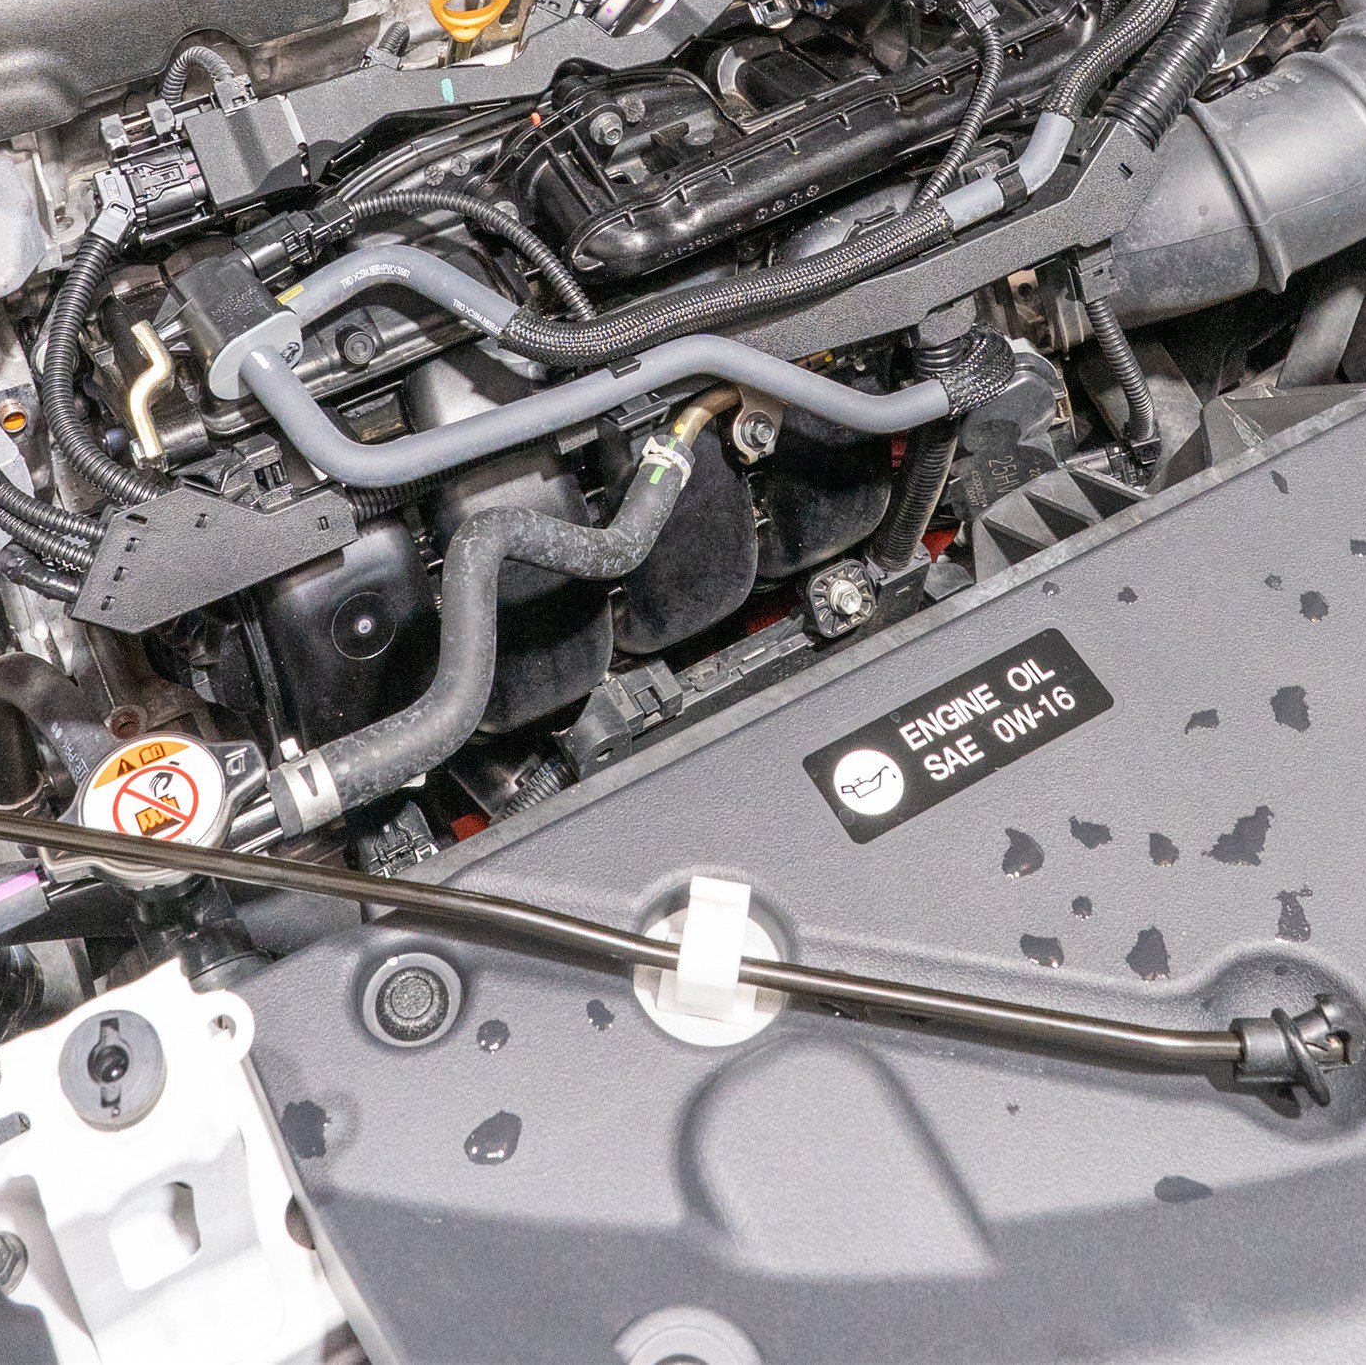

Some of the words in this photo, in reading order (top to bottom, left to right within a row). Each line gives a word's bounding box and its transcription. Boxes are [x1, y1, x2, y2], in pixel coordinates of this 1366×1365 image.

[898, 683, 1001, 751] ENGINE
[1007, 658, 1056, 692] OIL
[923, 734, 985, 782] SAE
[992, 685, 1076, 744] 0W-16
